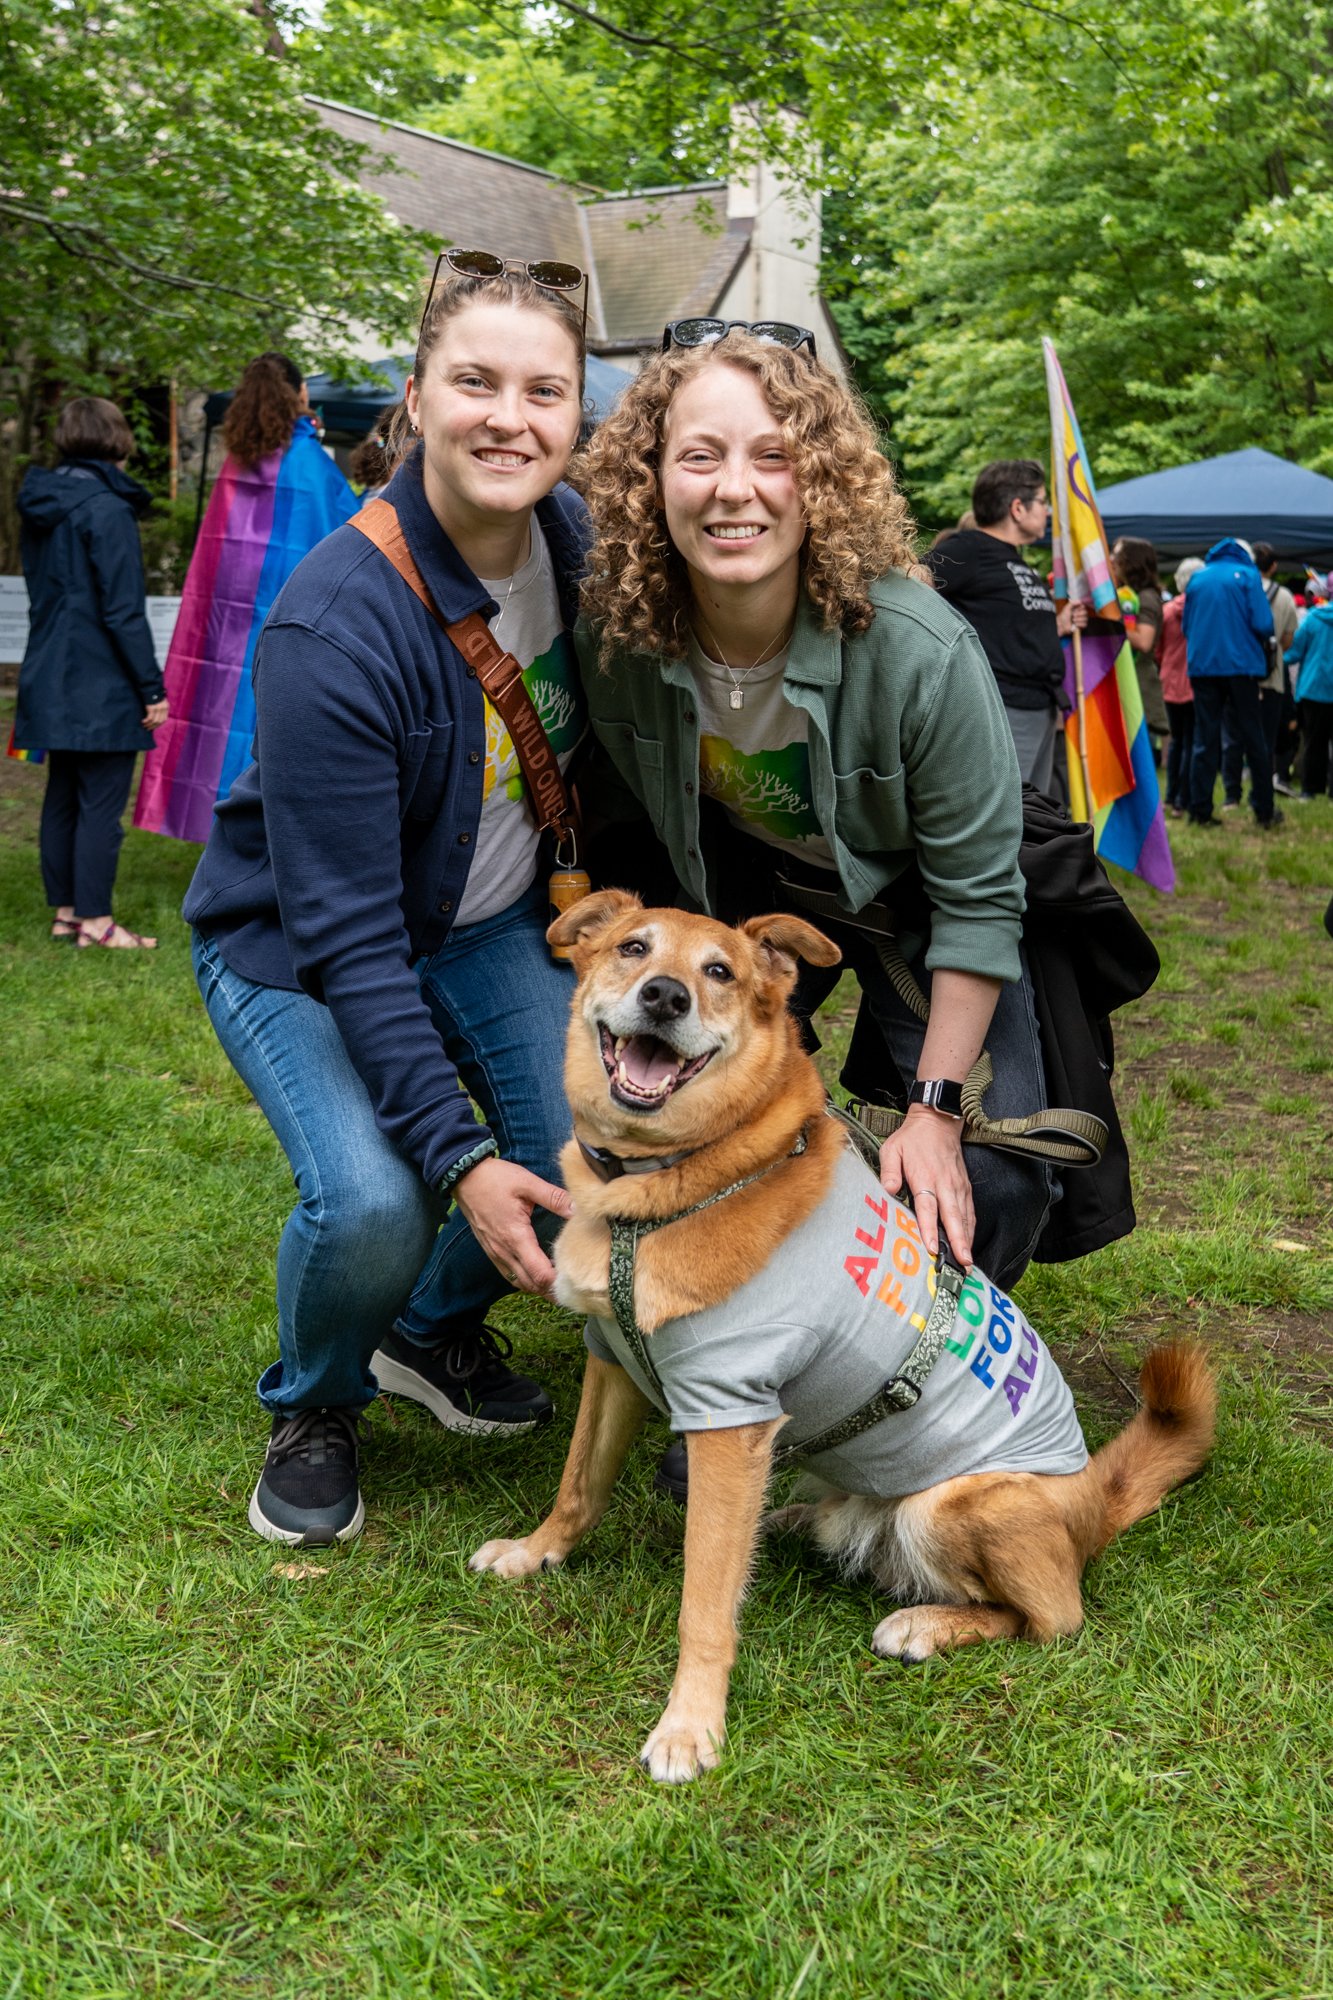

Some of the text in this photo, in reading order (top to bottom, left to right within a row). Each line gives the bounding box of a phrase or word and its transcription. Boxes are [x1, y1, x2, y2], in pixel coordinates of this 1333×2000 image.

[513, 701, 565, 820] WILD ONE
[843, 1193, 888, 1297] ALL
[876, 1207, 922, 1317] FOR
[944, 1266, 985, 1361] LOV
[970, 1286, 1015, 1390] FOR
[1003, 1325, 1039, 1418] ALL
